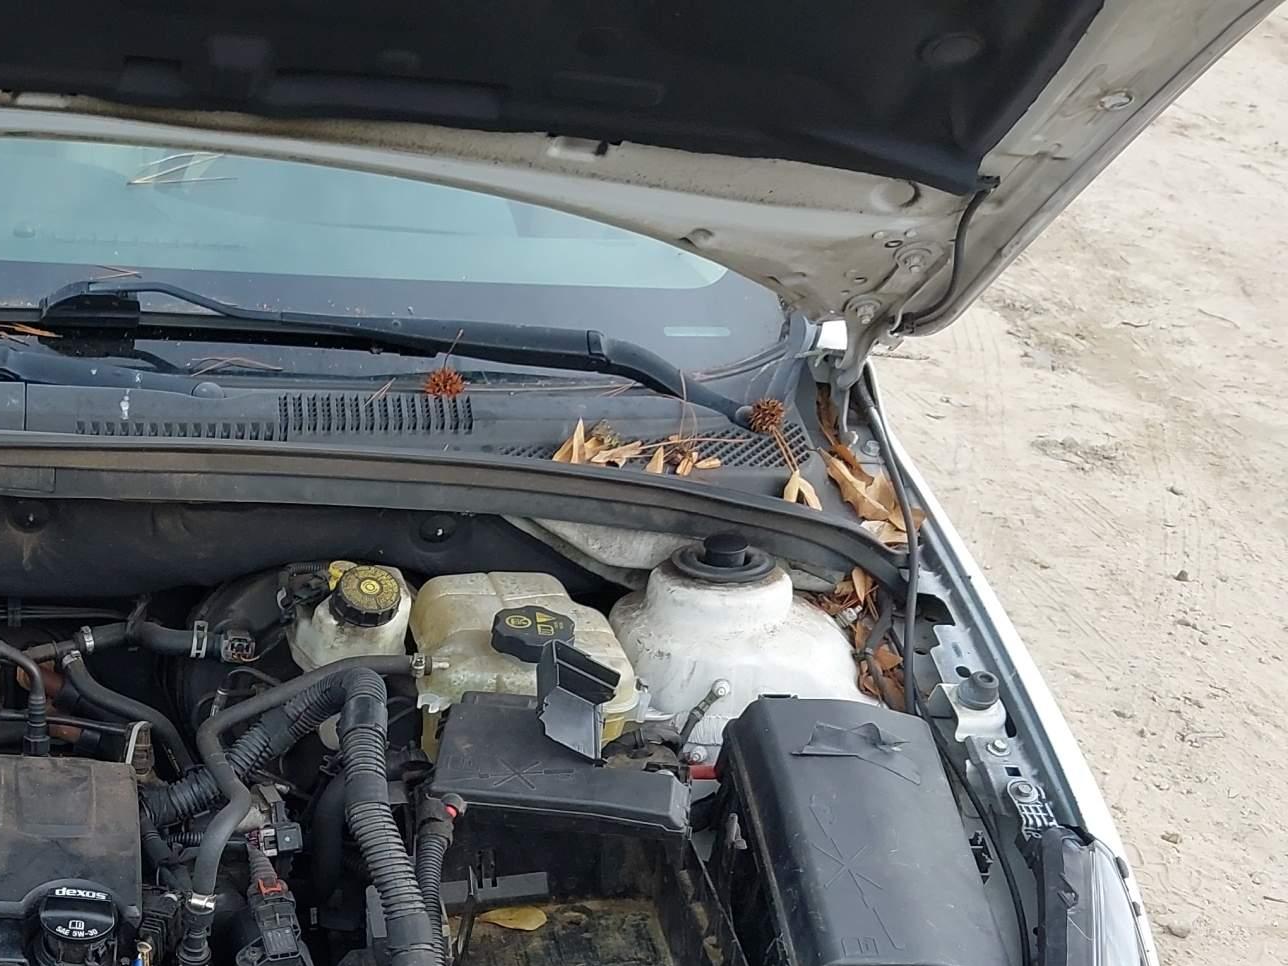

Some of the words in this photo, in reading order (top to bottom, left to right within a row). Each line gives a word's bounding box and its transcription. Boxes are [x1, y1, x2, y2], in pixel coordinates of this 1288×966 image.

[55, 887, 108, 900] dexos
[56, 926, 71, 936] SAE
[72, 928, 98, 937] 5W-30
